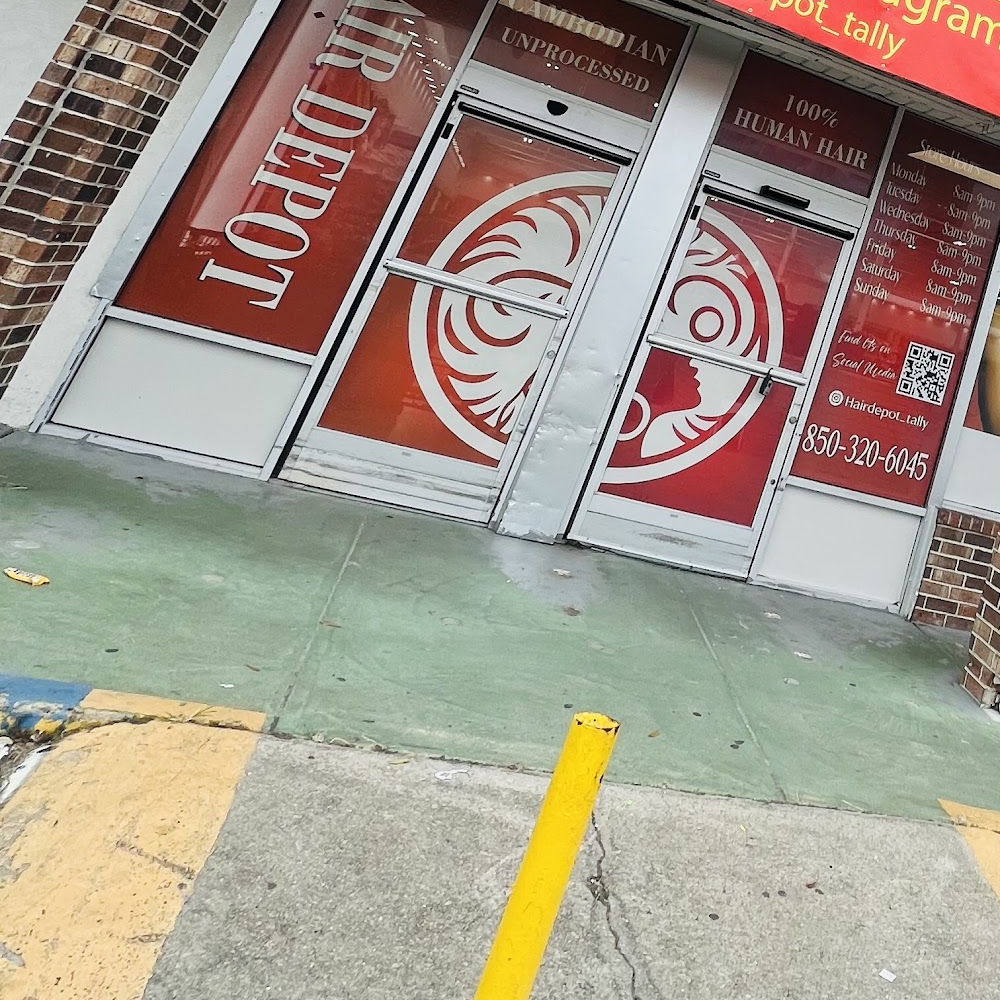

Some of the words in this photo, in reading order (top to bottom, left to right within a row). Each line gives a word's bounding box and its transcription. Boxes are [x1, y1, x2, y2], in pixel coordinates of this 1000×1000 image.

[501, 26, 650, 93] UNPROCESSED
[784, 93, 839, 129] 100%
[733, 106, 814, 150] HUMAN
[816, 138, 870, 171] HAIR
[890, 162, 928, 190] Monday
[199, 84, 378, 310] DEPOT
[886, 181, 921, 204] Tuesday
[873, 217, 918, 247] Thursday
[879, 200, 931, 232] Wednesday
[865, 237, 896, 263] Friday
[860, 257, 902, 287] Saturday
[853, 277, 890, 304] Sunday
[844, 395, 929, 431] Hairdepot_tally
[802, 423, 930, 481] 850-320-6045
